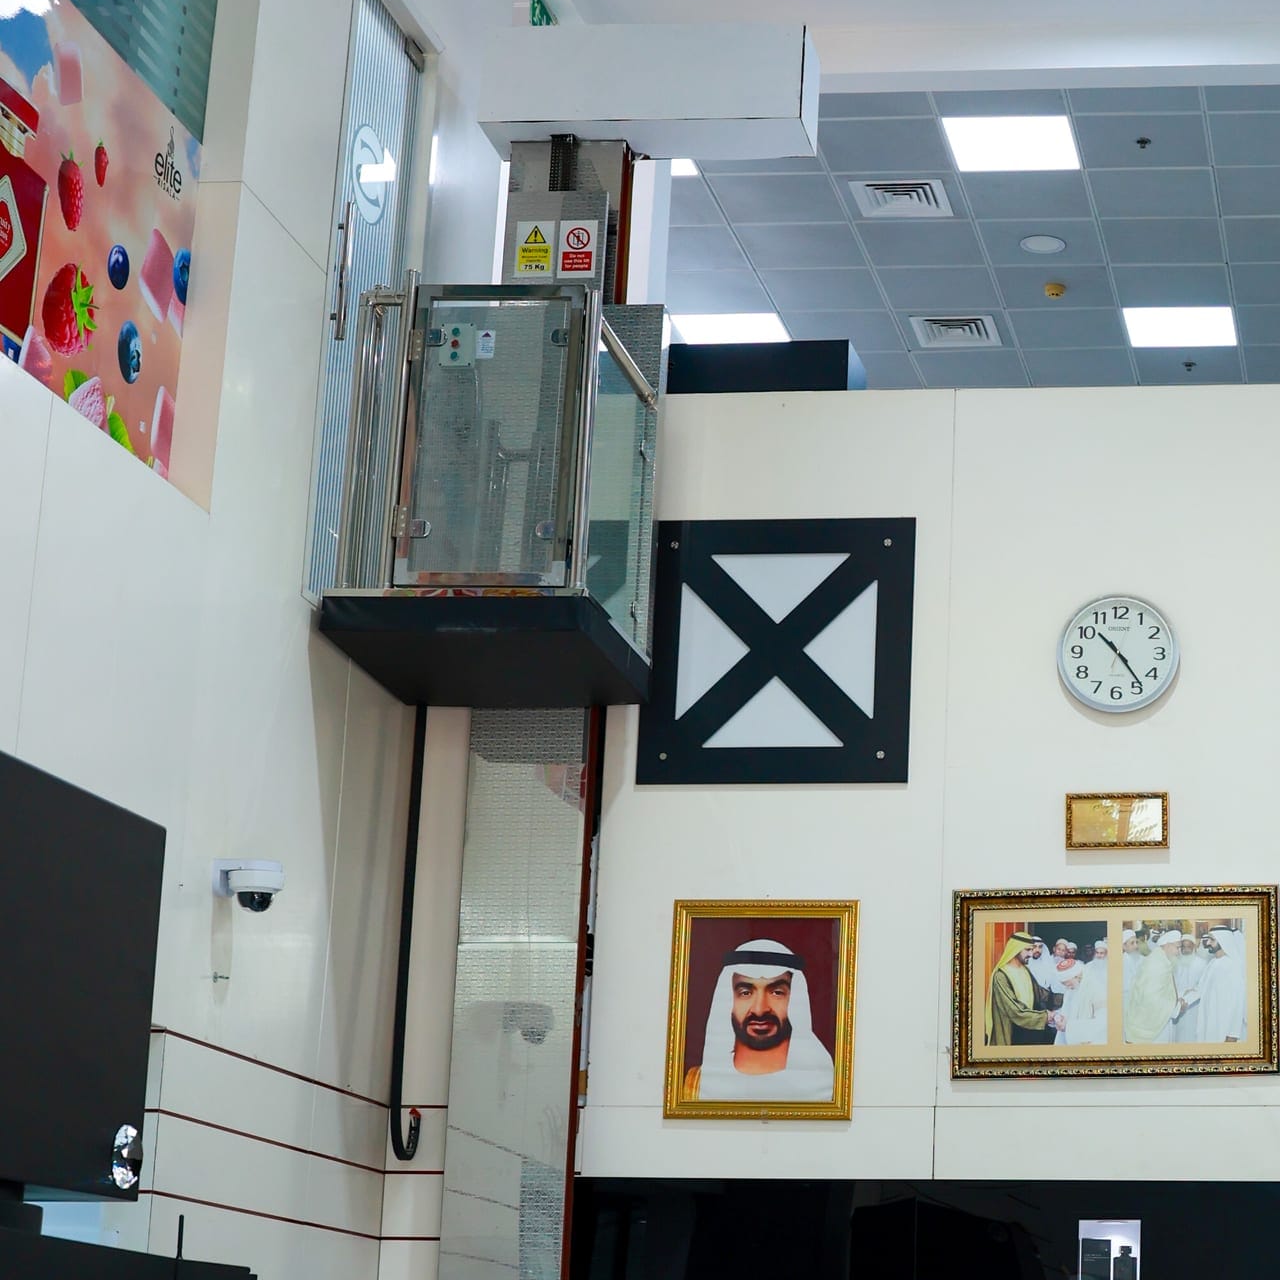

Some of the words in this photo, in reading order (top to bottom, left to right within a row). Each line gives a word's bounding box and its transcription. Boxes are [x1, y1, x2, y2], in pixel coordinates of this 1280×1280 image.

[154, 152, 182, 194] elite
[535, 263, 545, 271] Kg
[1092, 611, 1107, 625] 11
[1112, 606, 1130, 620] 12
[1137, 612, 1144, 626] 1
[1078, 625, 1096, 640] 10
[1148, 625, 1161, 640] 2
[1071, 645, 1083, 658] 9
[1153, 646, 1166, 661] 3
[1076, 665, 1088, 679] 8
[1145, 667, 1158, 680] 4
[1090, 680, 1103, 694] 7
[1110, 686, 1122, 700] 6
[1130, 680, 1144, 695] 5
